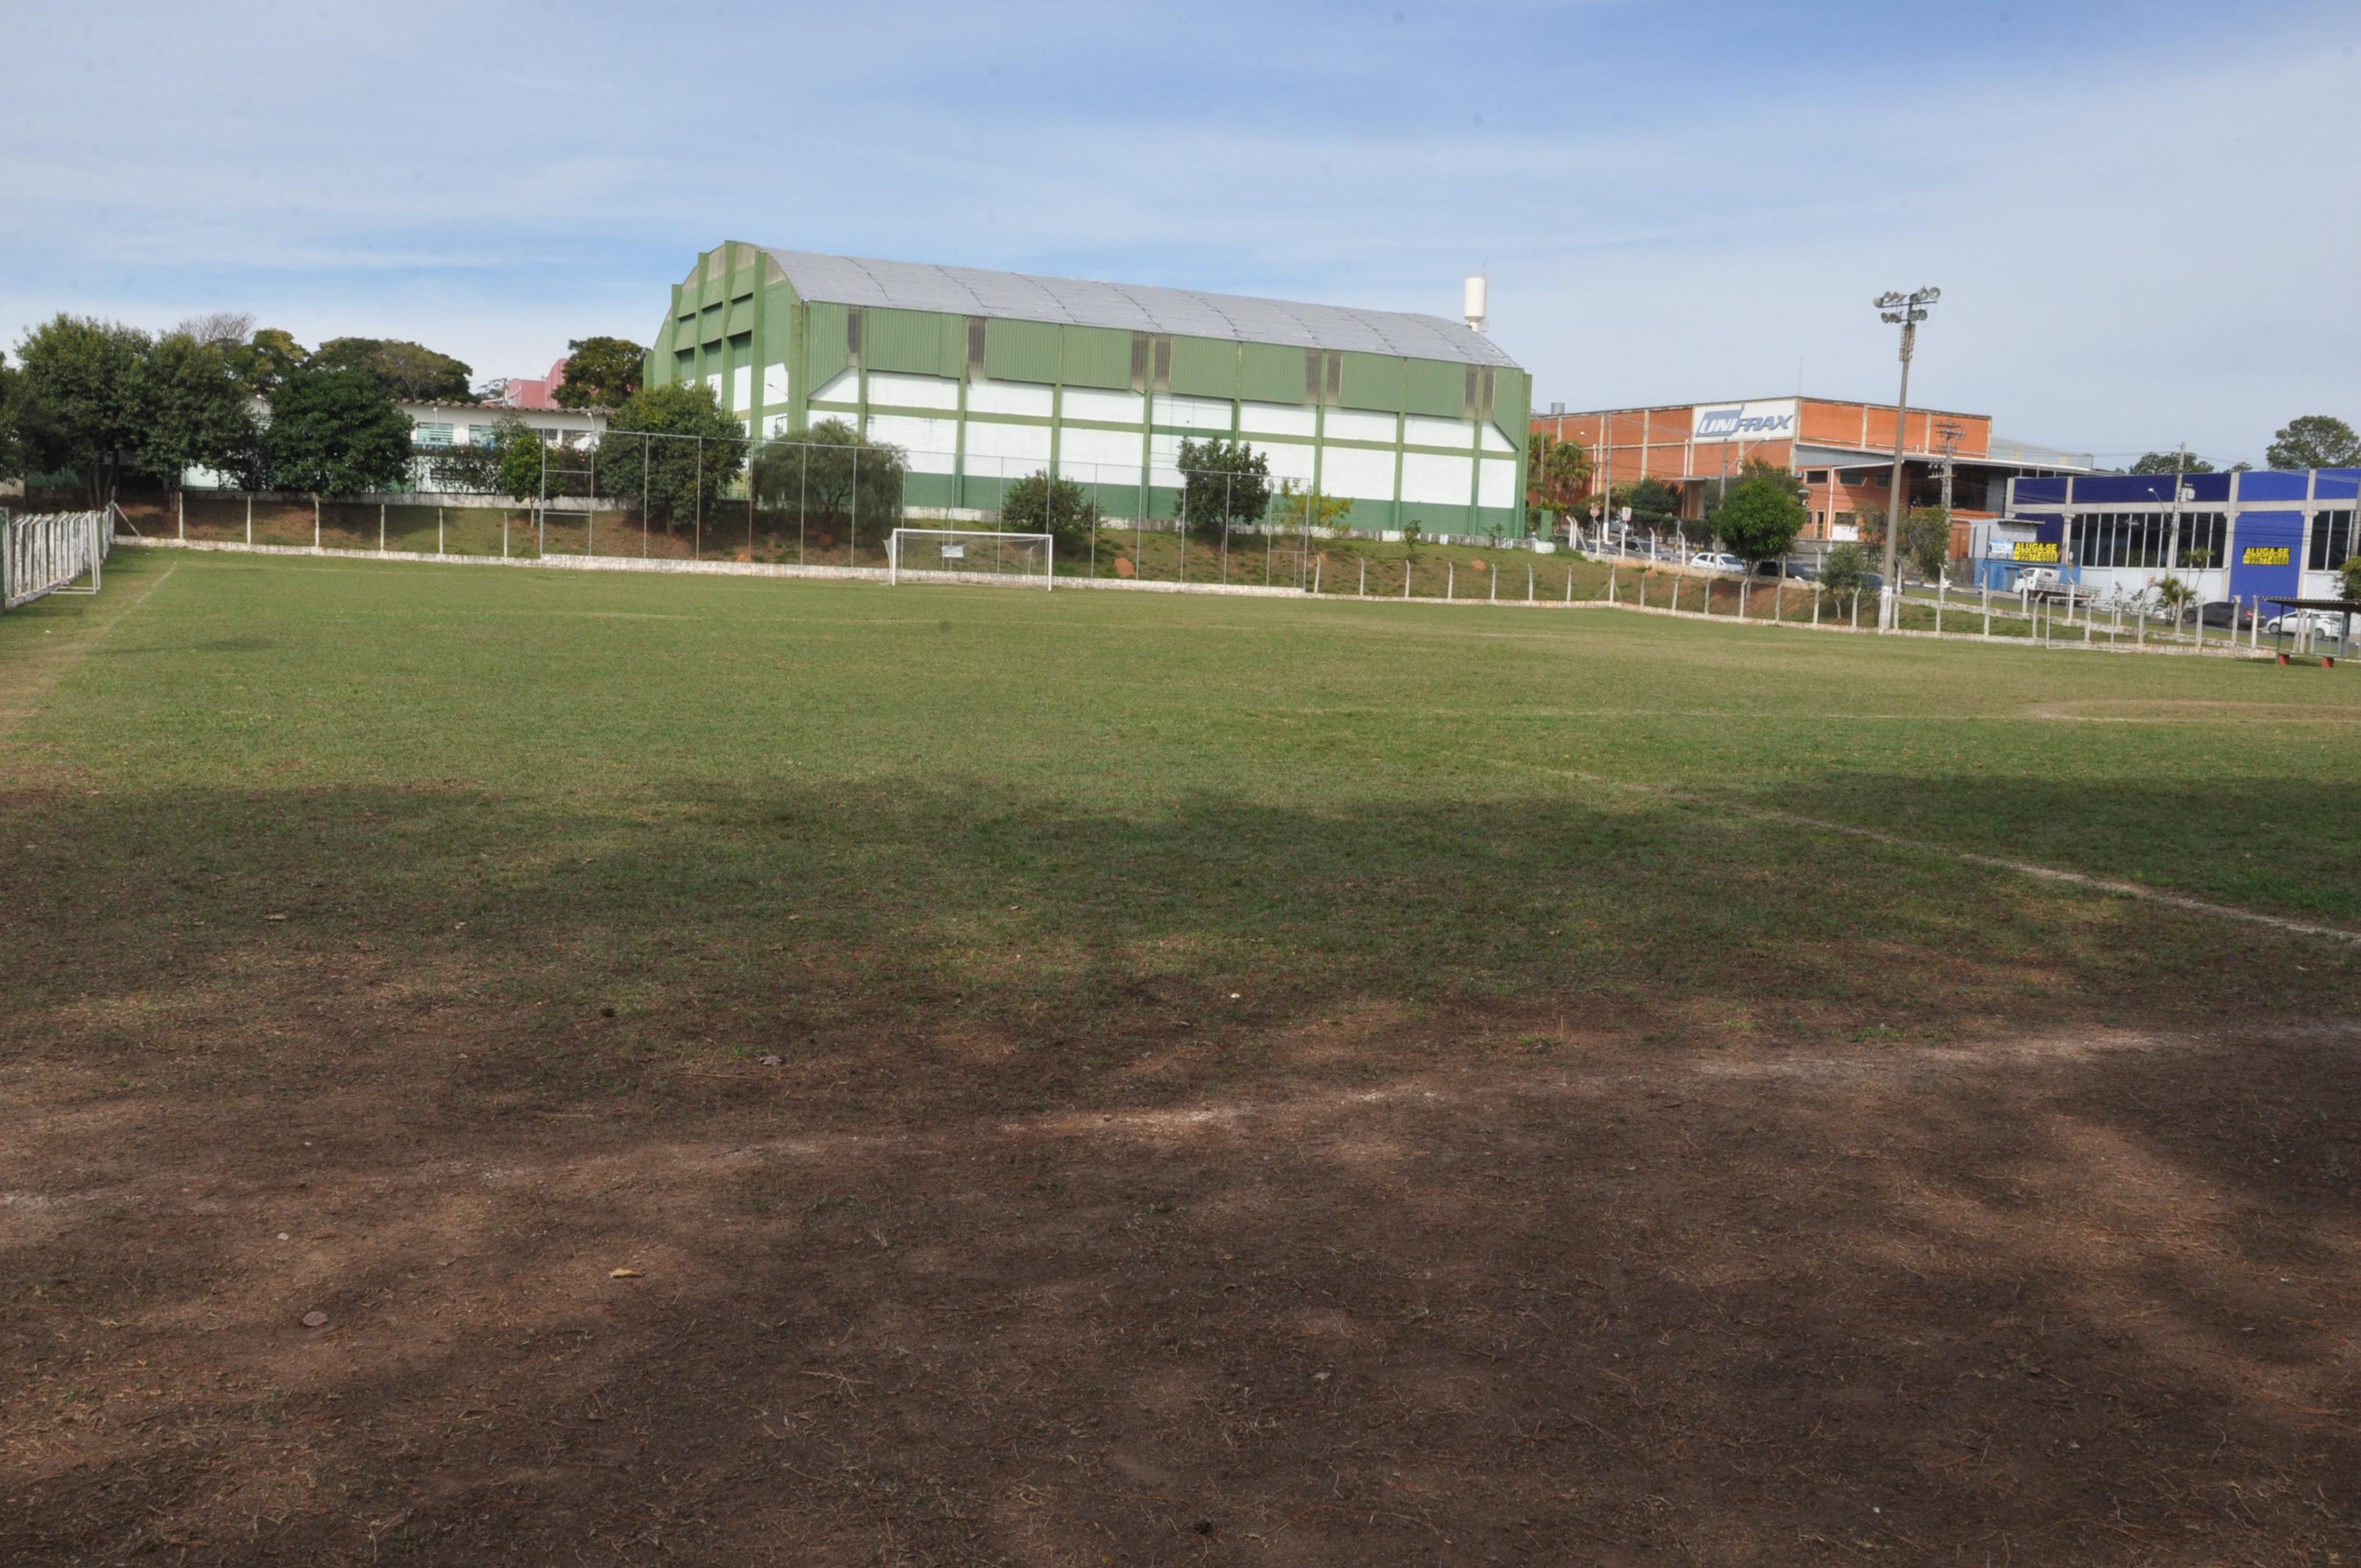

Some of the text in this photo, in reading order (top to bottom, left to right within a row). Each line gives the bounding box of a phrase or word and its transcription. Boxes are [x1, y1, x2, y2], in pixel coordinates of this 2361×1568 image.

[1698, 414, 1794, 434] UNIFRAX
[2014, 542, 2058, 553] ALUGA-SE
[2245, 547, 2290, 556] ALUGA-SE
